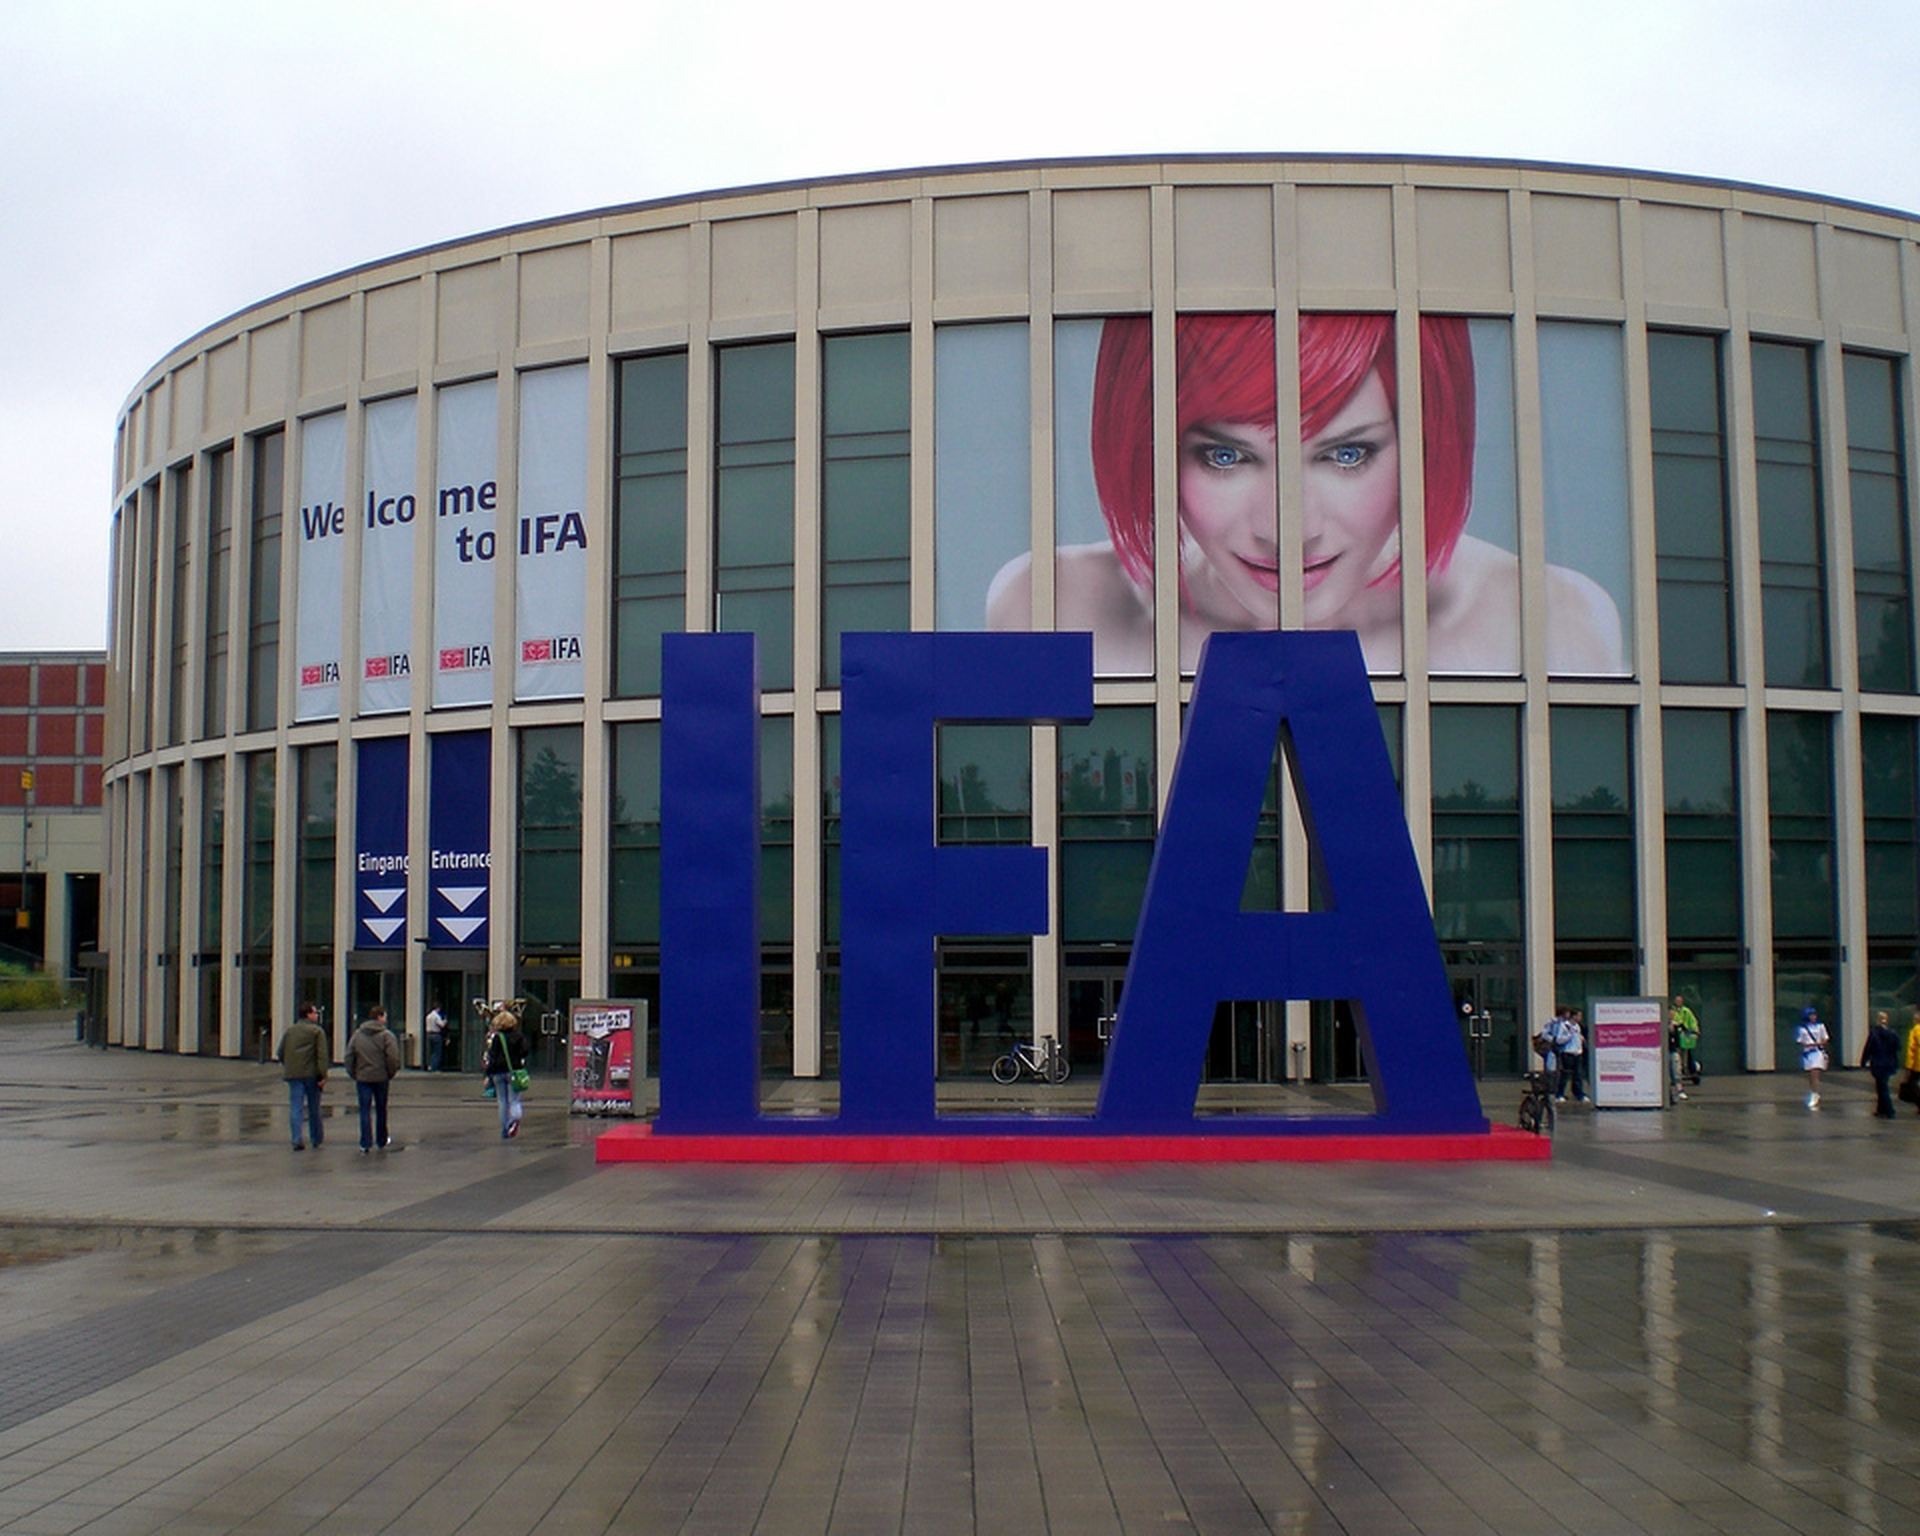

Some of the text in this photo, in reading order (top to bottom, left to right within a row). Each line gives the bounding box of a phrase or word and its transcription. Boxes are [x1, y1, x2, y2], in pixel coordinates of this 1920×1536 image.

[456, 511, 587, 563] to IFA
[466, 645, 491, 668] IFA
[553, 637, 581, 660] IFA
[321, 662, 340, 684] IFA
[388, 654, 410, 676] IFA
[431, 850, 491, 869] Entrance
[661, 631, 1490, 1134] IFA
